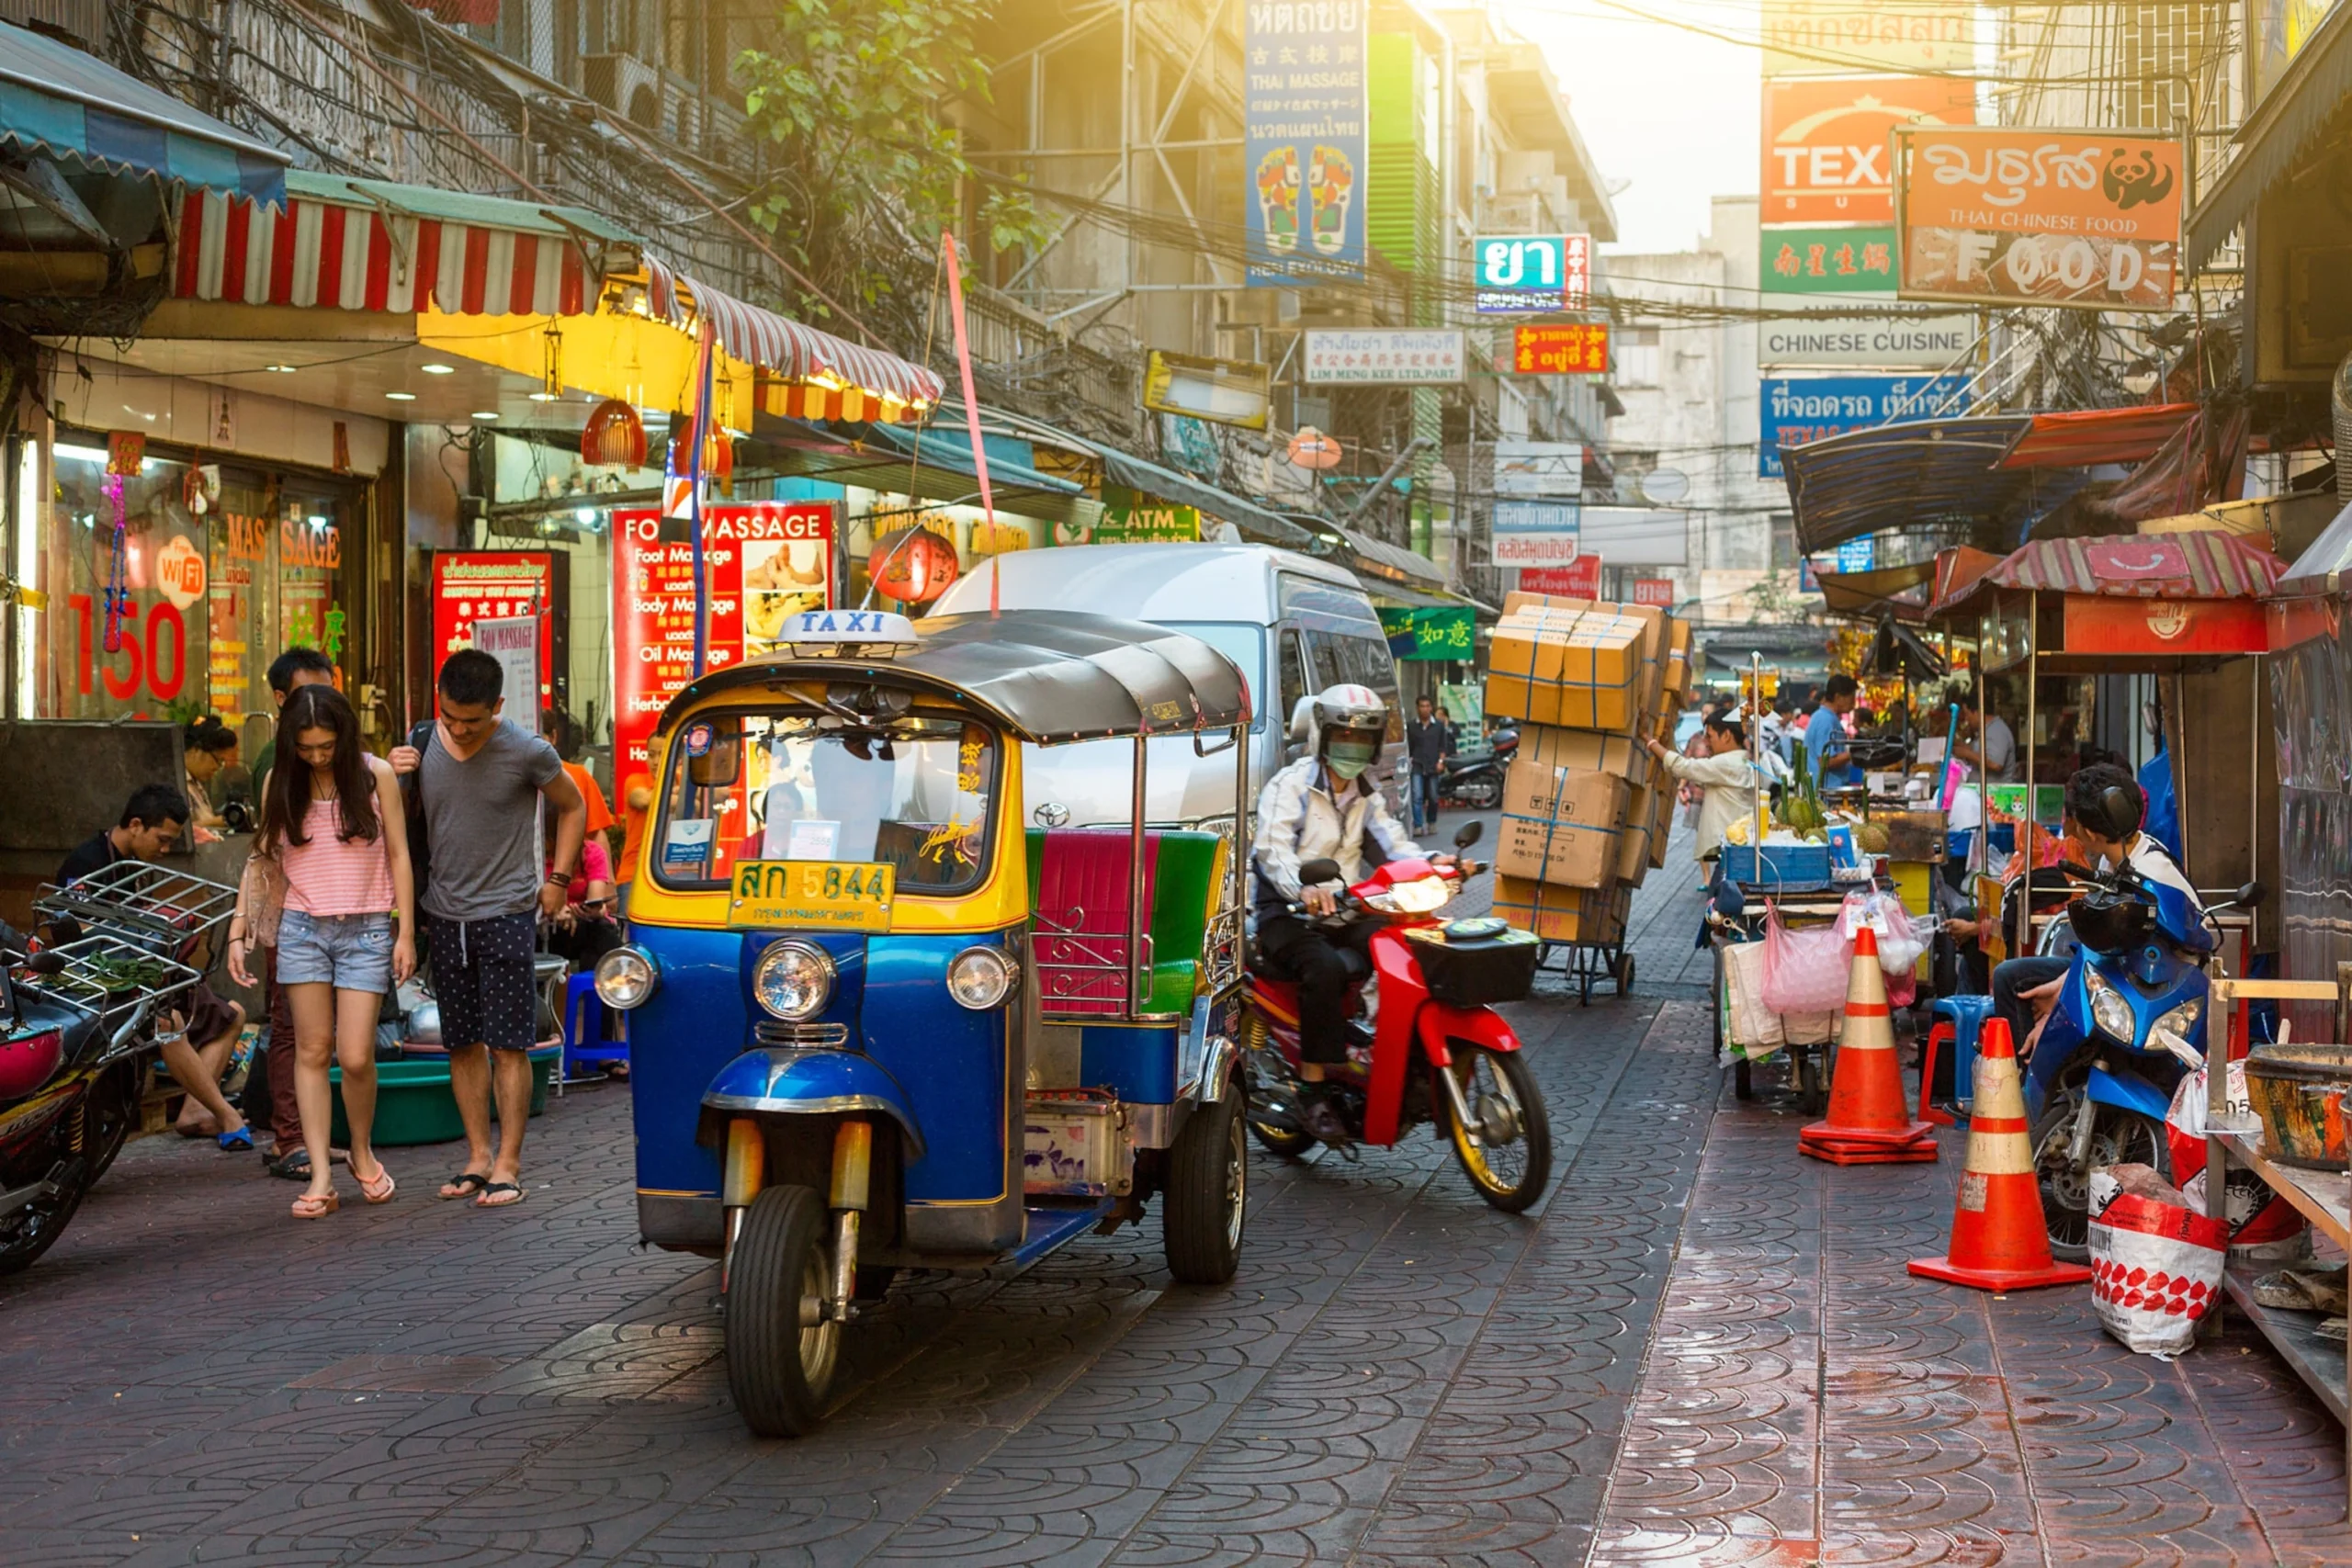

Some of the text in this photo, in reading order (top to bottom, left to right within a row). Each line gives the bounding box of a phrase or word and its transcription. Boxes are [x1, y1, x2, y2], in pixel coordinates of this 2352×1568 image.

[1289, 71, 1360, 88] MASSAGE
[1250, 115, 1360, 139] นวดแผนไทย
[1773, 144, 1913, 186] TEX
[1950, 209, 2138, 234] THAI CHINESE FOOD
[1485, 241, 1555, 286] ยา
[1955, 234, 2143, 292] FOOD
[1770, 333, 1964, 353] CHINESE CUISINE
[1310, 369, 1331, 379] LIM
[1336, 369, 1368, 379] MENG
[1372, 369, 1395, 379] KEE
[1770, 381, 1871, 417] ที่จอดรถ
[626, 519, 659, 541] FO
[1125, 510, 1176, 529] ATM
[635, 548, 732, 566] Foot Maage
[632, 596, 736, 615] Body Maage
[799, 613, 885, 633] TAXI
[1418, 620, 1471, 647] 如意
[69, 593, 186, 701] 150
[498, 626, 533, 650] MASSAGE
[639, 647, 730, 665] Oil Masage
[740, 863, 886, 902] สก 5844
